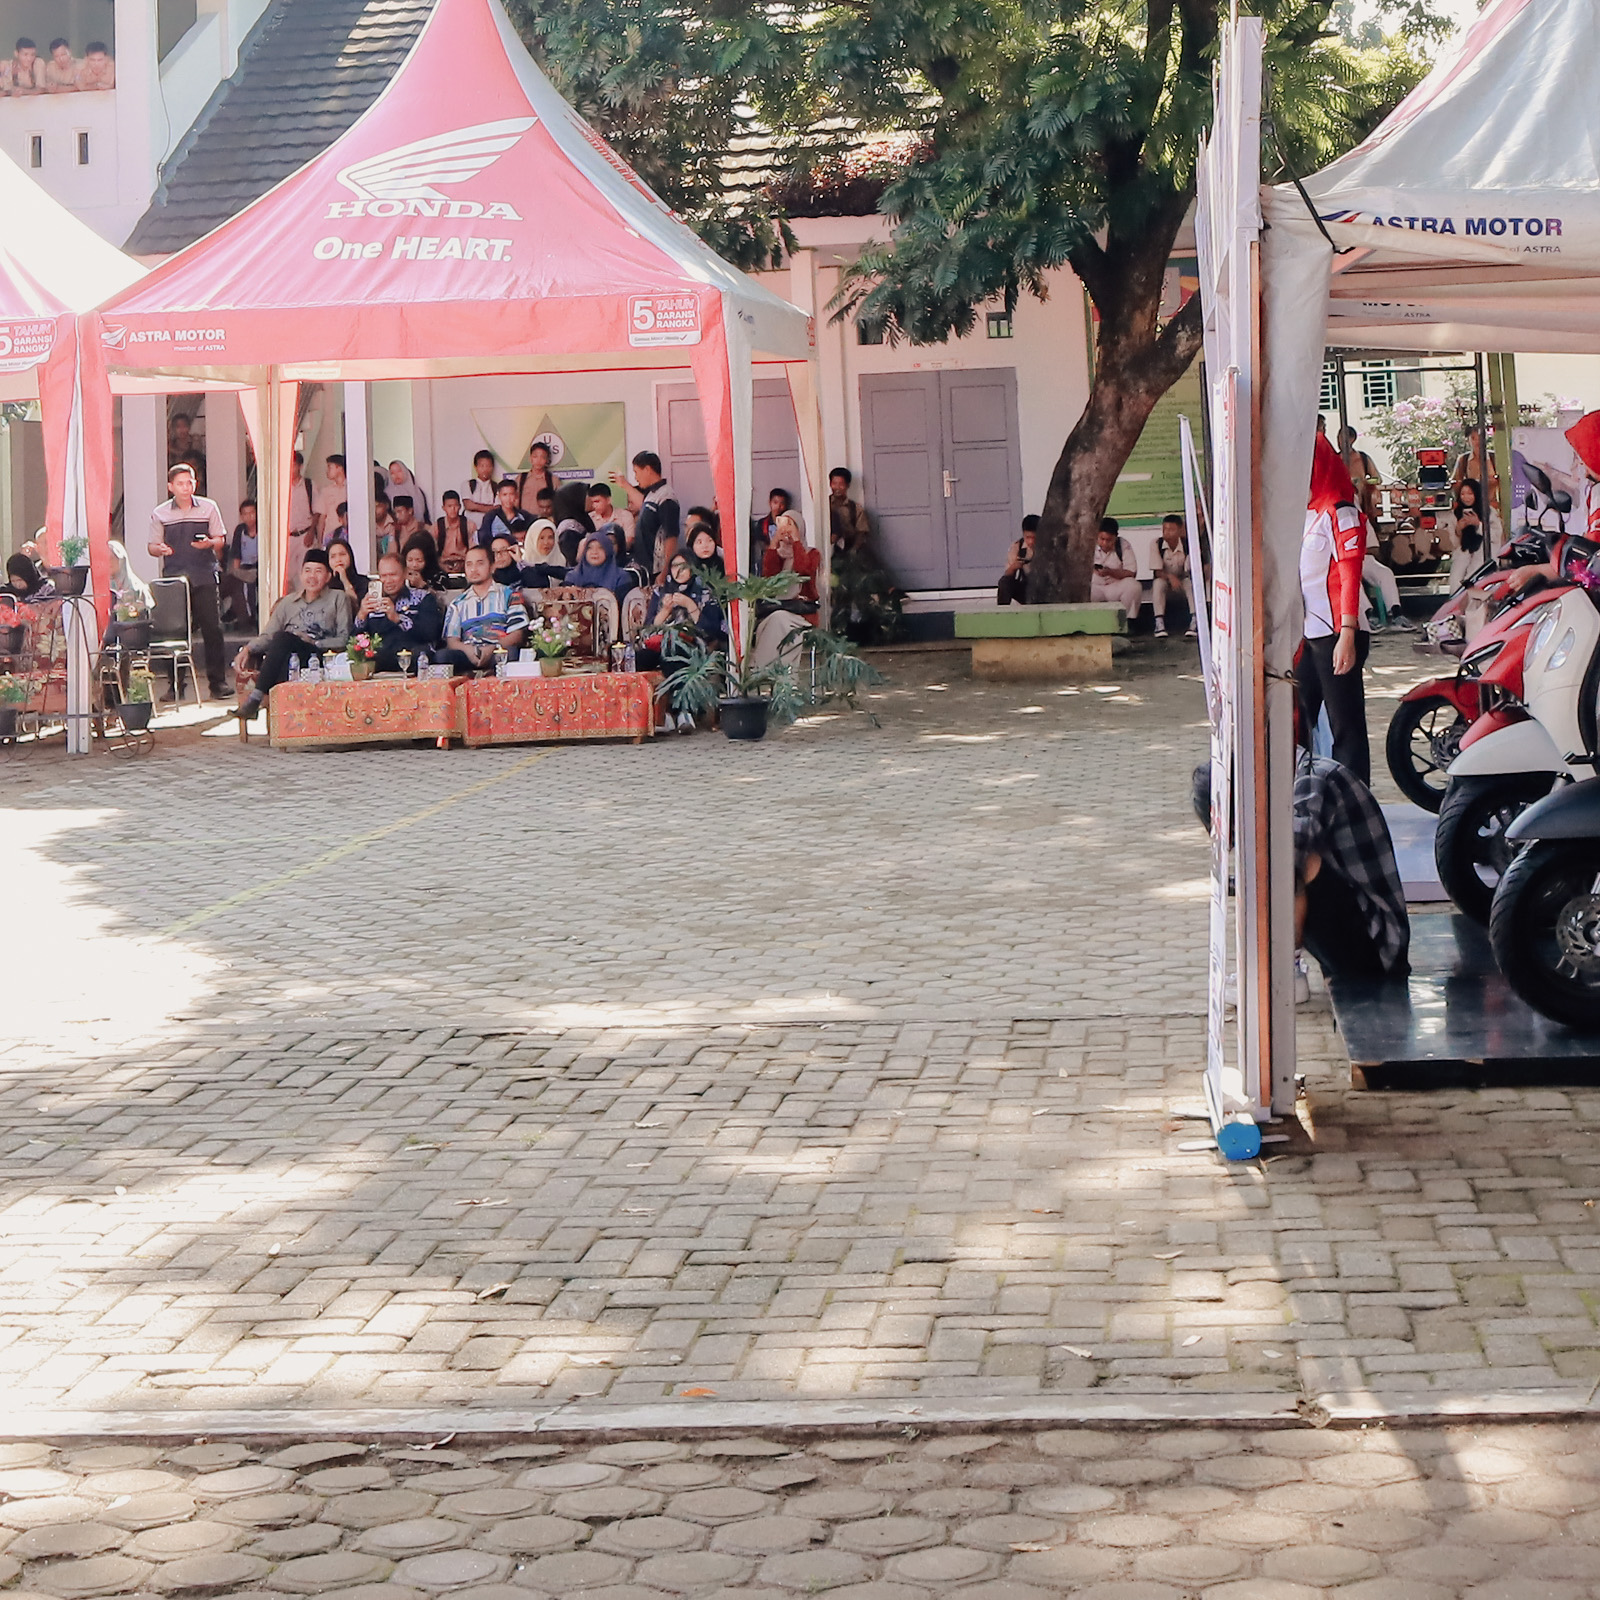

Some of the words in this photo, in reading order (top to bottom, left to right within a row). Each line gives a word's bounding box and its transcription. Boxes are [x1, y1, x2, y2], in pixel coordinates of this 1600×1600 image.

[324, 198, 524, 221] HONDA
[1466, 217, 1562, 236] MOTOR
[313, 236, 384, 261] One
[390, 236, 513, 262] HEART.
[633, 300, 655, 330] 5
[656, 310, 696, 319] GARANSI
[656, 319, 695, 329] RANGKA
[13, 335, 53, 345] GARANSI
[129, 331, 172, 342] ASTRA
[174, 329, 226, 341] MOTOR
[13, 343, 50, 354] RANGKA
